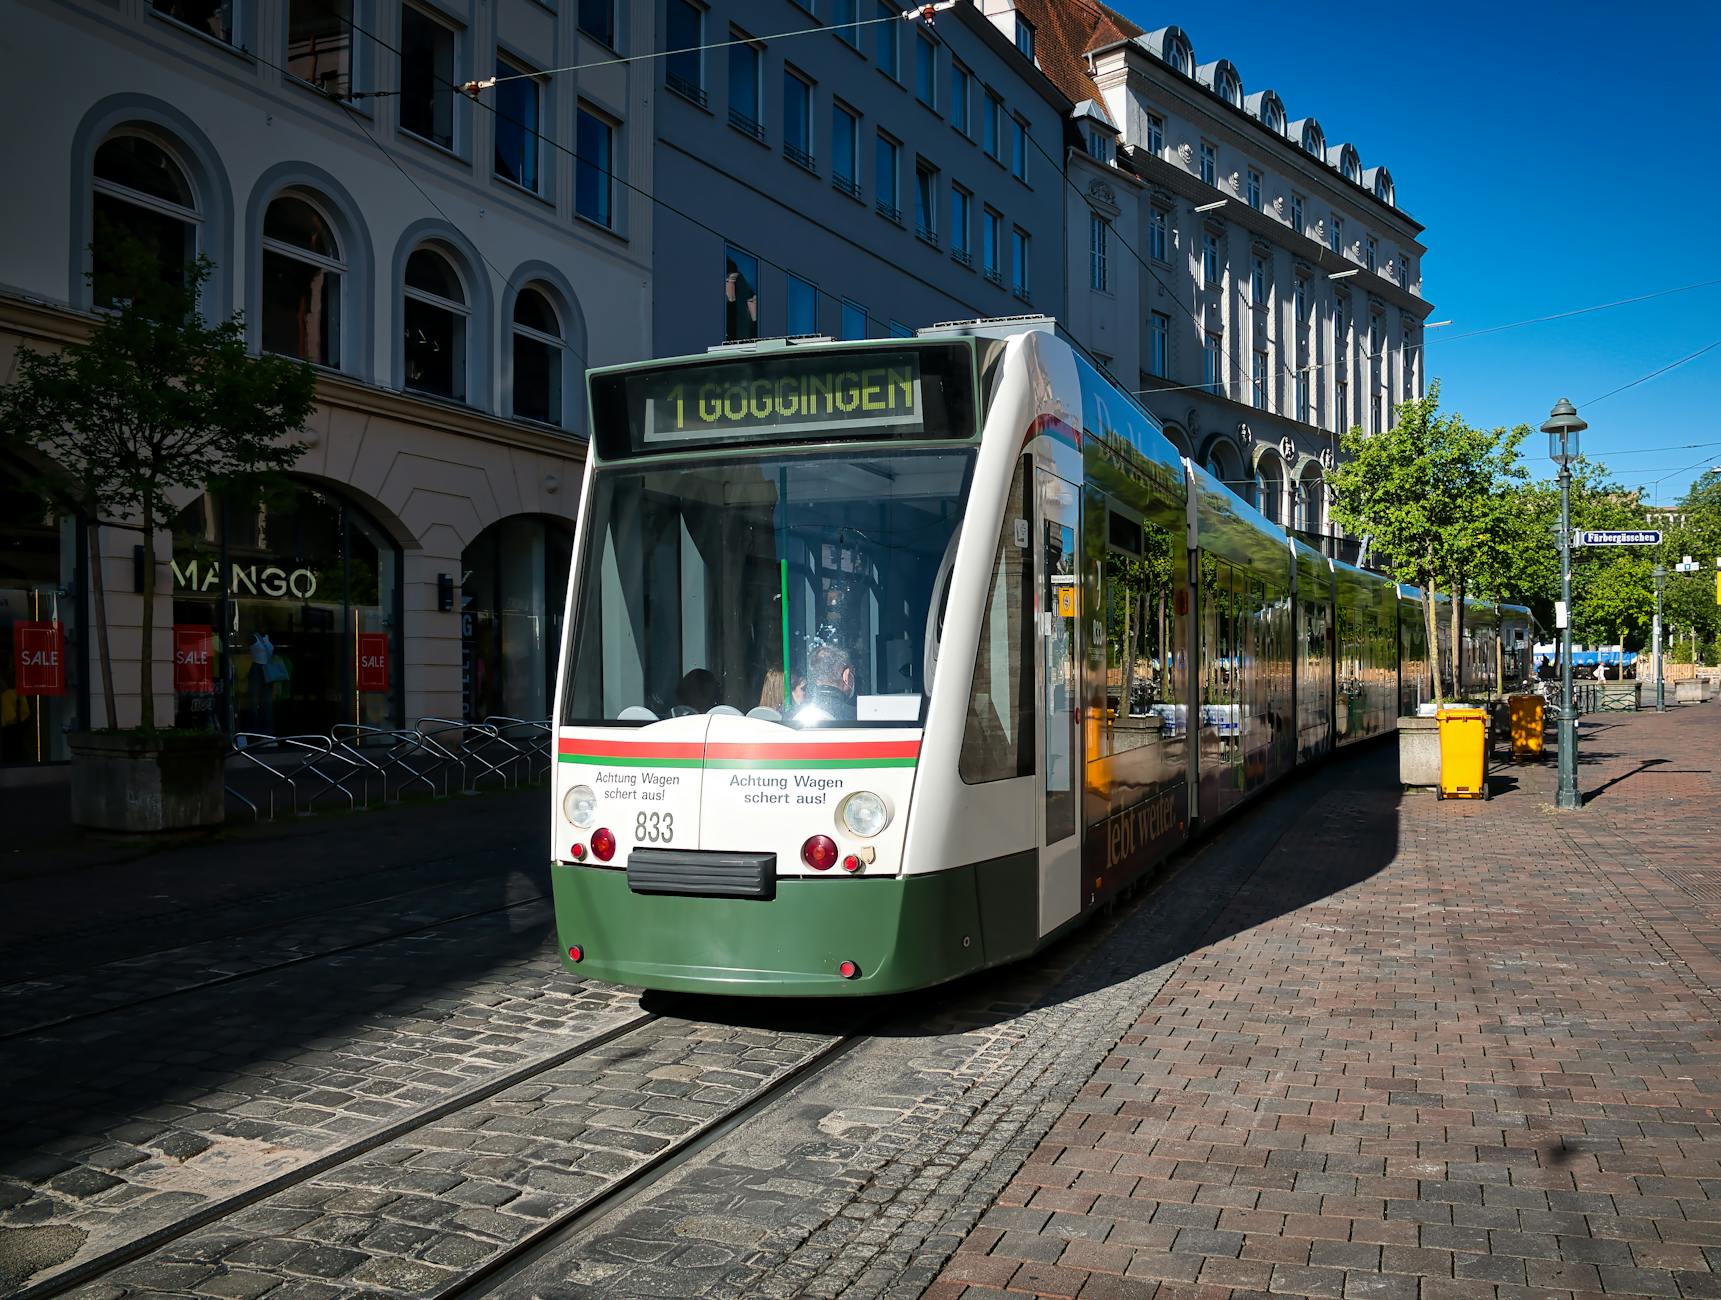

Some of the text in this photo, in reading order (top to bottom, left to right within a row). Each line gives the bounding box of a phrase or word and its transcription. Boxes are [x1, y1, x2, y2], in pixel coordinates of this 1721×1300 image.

[667, 385, 684, 429] 1
[1587, 533, 1655, 543] Färbergässchen
[170, 557, 317, 599] MANGO
[21, 650, 59, 666] SALE
[175, 650, 209, 666] SALE
[361, 656, 385, 668] SALE
[595, 771, 680, 787] Achtung Wagen
[730, 774, 844, 792] Achtung Wagen
[604, 788, 665, 801] schert aus!
[744, 791, 827, 805] schert aus!
[635, 811, 674, 843] 833
